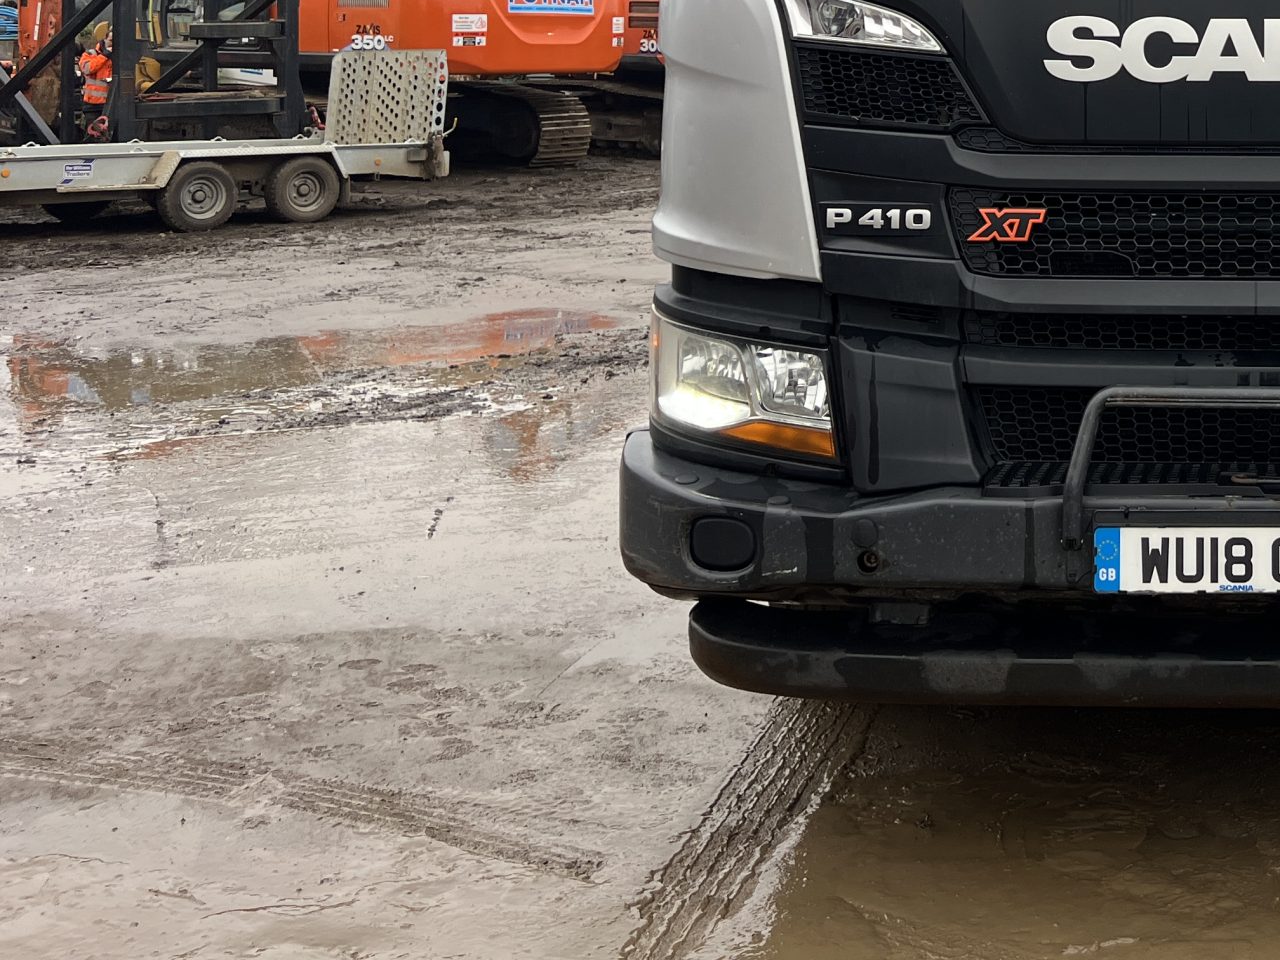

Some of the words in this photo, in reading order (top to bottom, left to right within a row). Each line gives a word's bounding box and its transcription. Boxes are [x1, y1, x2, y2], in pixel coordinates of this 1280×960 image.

[826, 207, 852, 229] P
[858, 208, 931, 230] 410
[967, 207, 1047, 242] XT
[1141, 536, 1254, 583] WU18
[1099, 568, 1117, 582] GB
[1219, 584, 1254, 592] SCANIA
